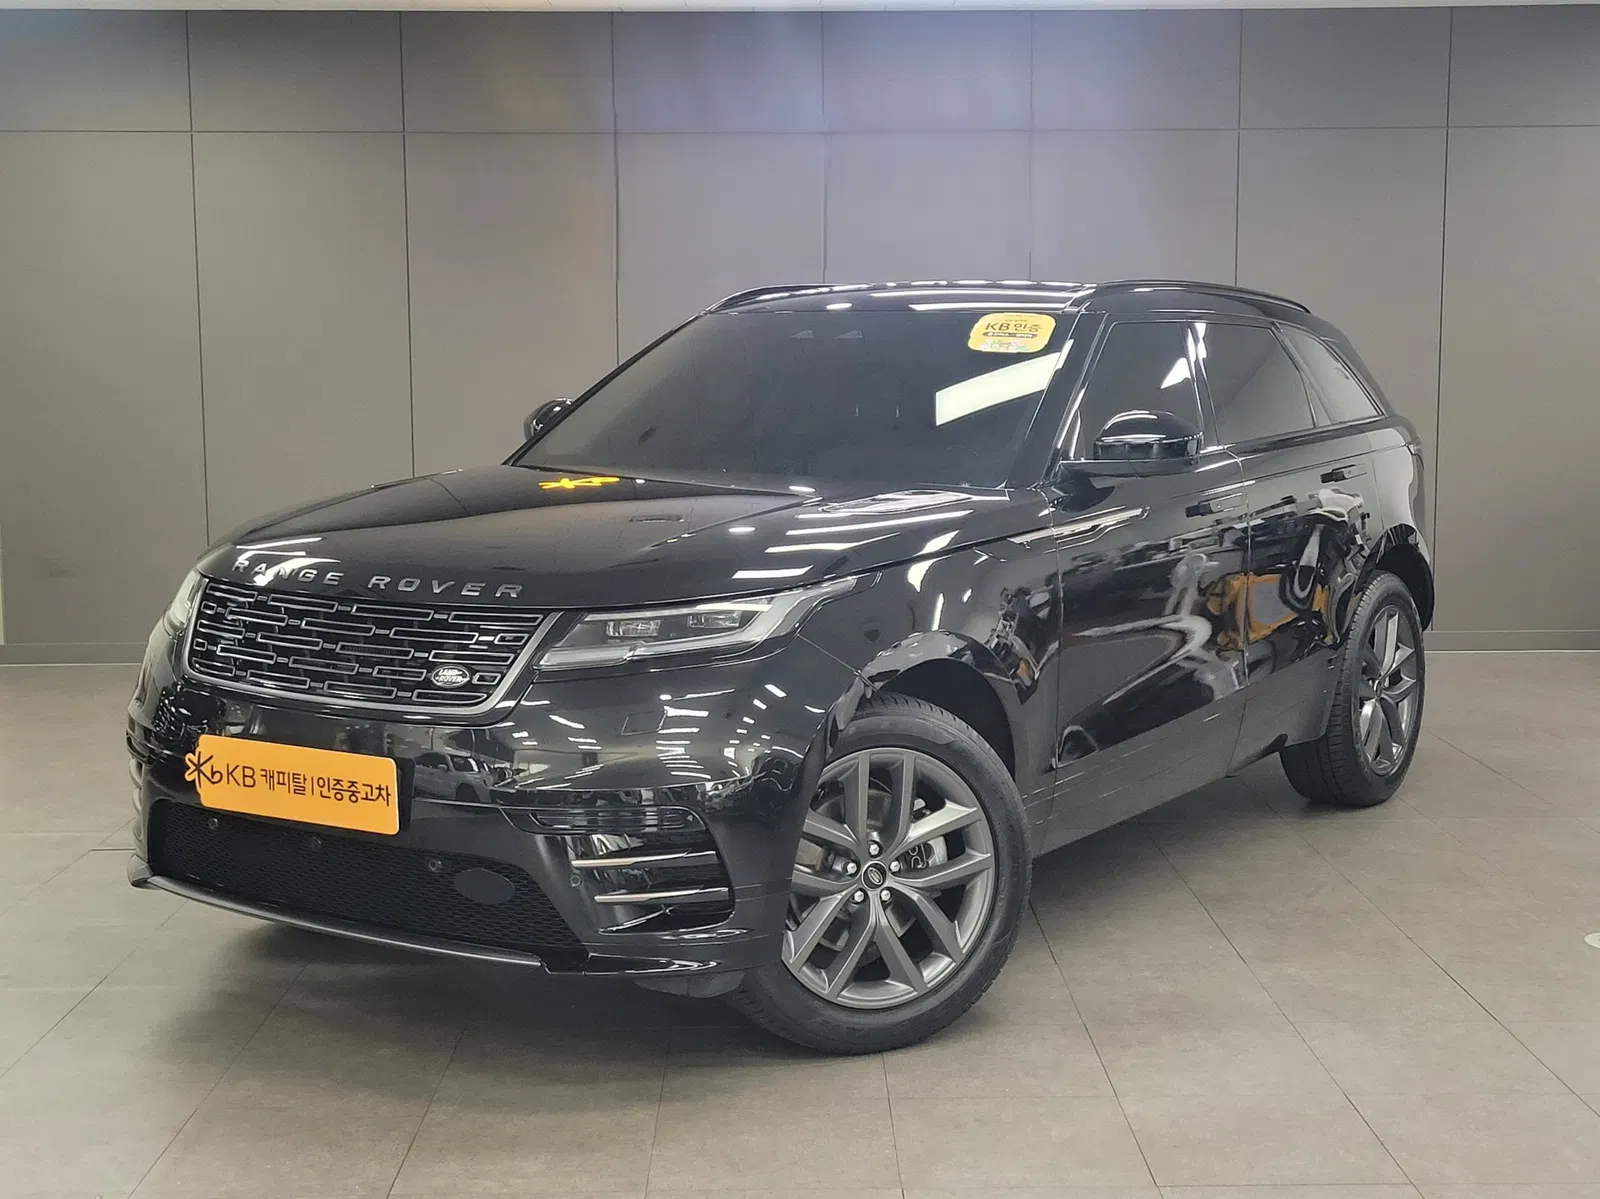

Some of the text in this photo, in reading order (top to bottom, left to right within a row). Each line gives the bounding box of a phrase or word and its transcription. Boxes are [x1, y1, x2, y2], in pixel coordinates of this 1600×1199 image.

[985, 323, 1042, 333] KB 인증
[232, 560, 523, 598] RANGE ROVER
[226, 763, 256, 788] KB
